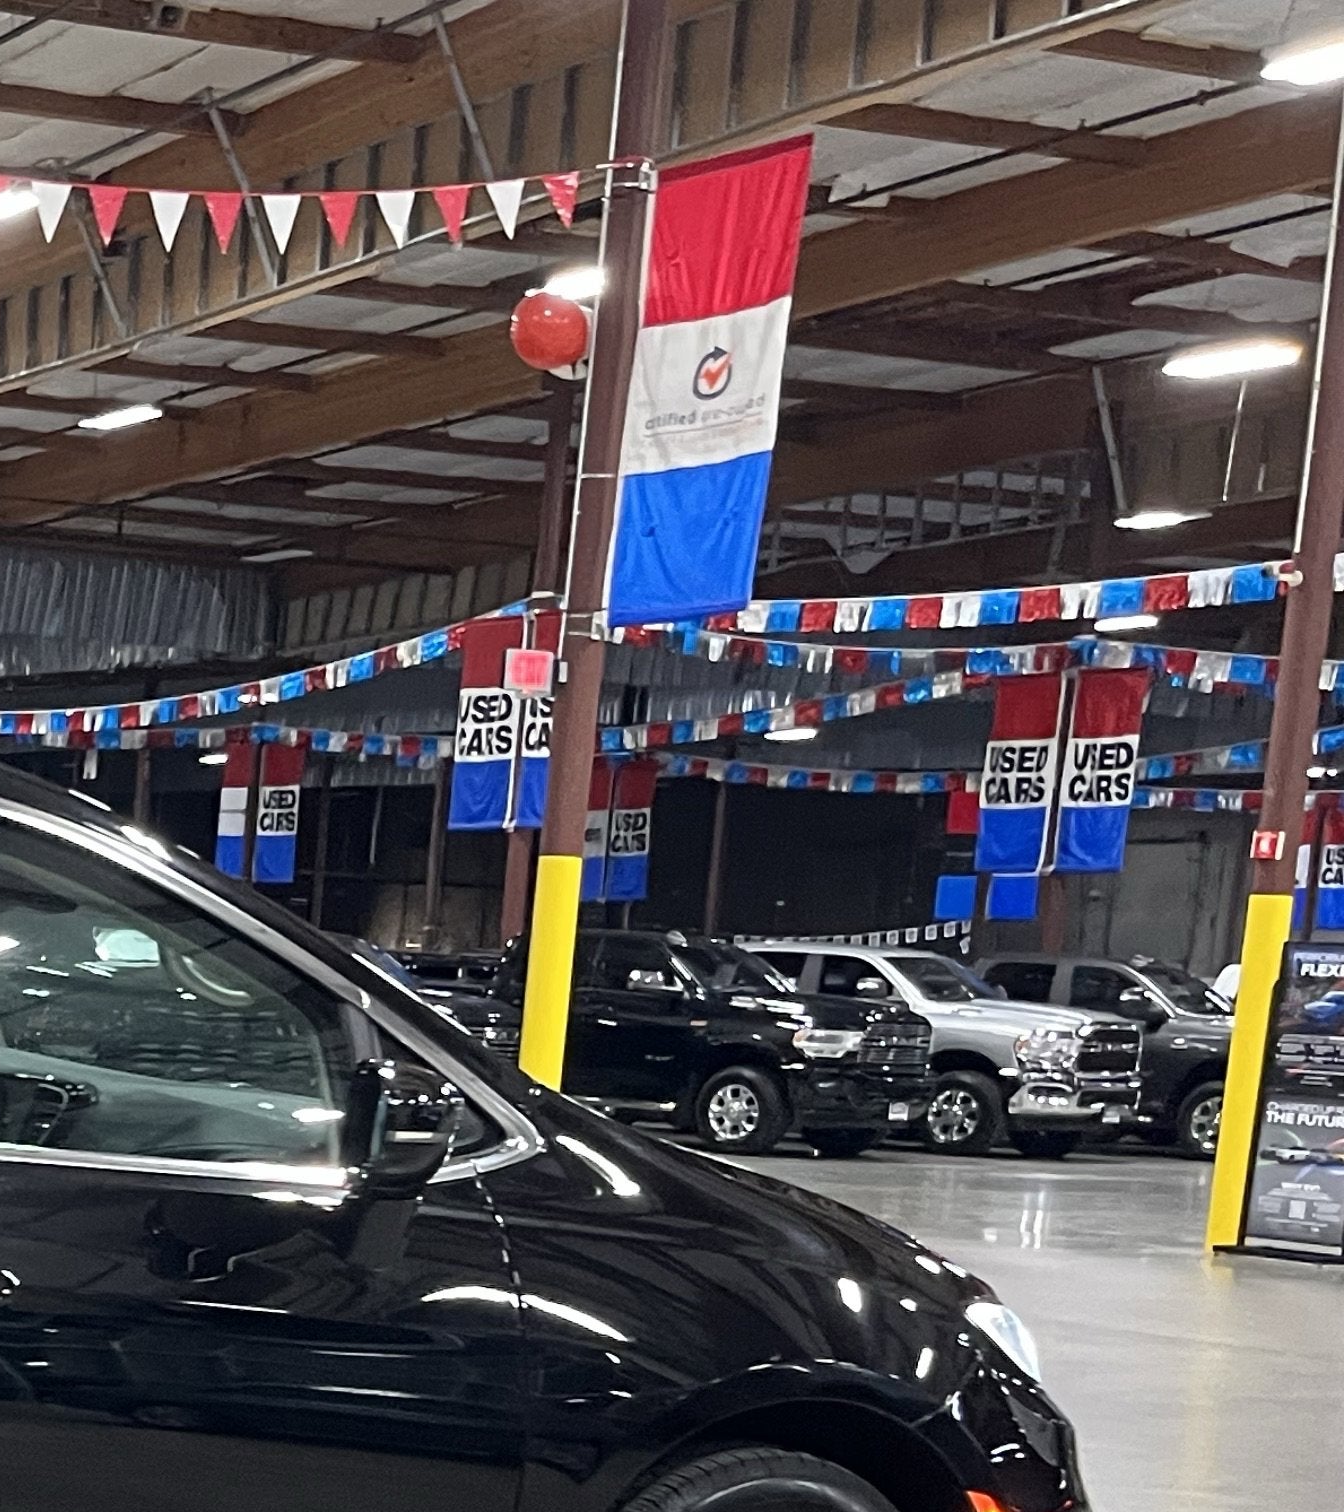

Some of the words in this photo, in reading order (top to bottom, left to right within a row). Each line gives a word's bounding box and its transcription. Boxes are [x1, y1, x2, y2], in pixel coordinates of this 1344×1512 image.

[459, 693, 513, 724] USED
[989, 745, 1049, 773] USED
[262, 789, 297, 810] USED
[984, 775, 1046, 804] CARS
[1068, 772, 1132, 802] CARS
[1265, 1110, 1295, 1125] THE
